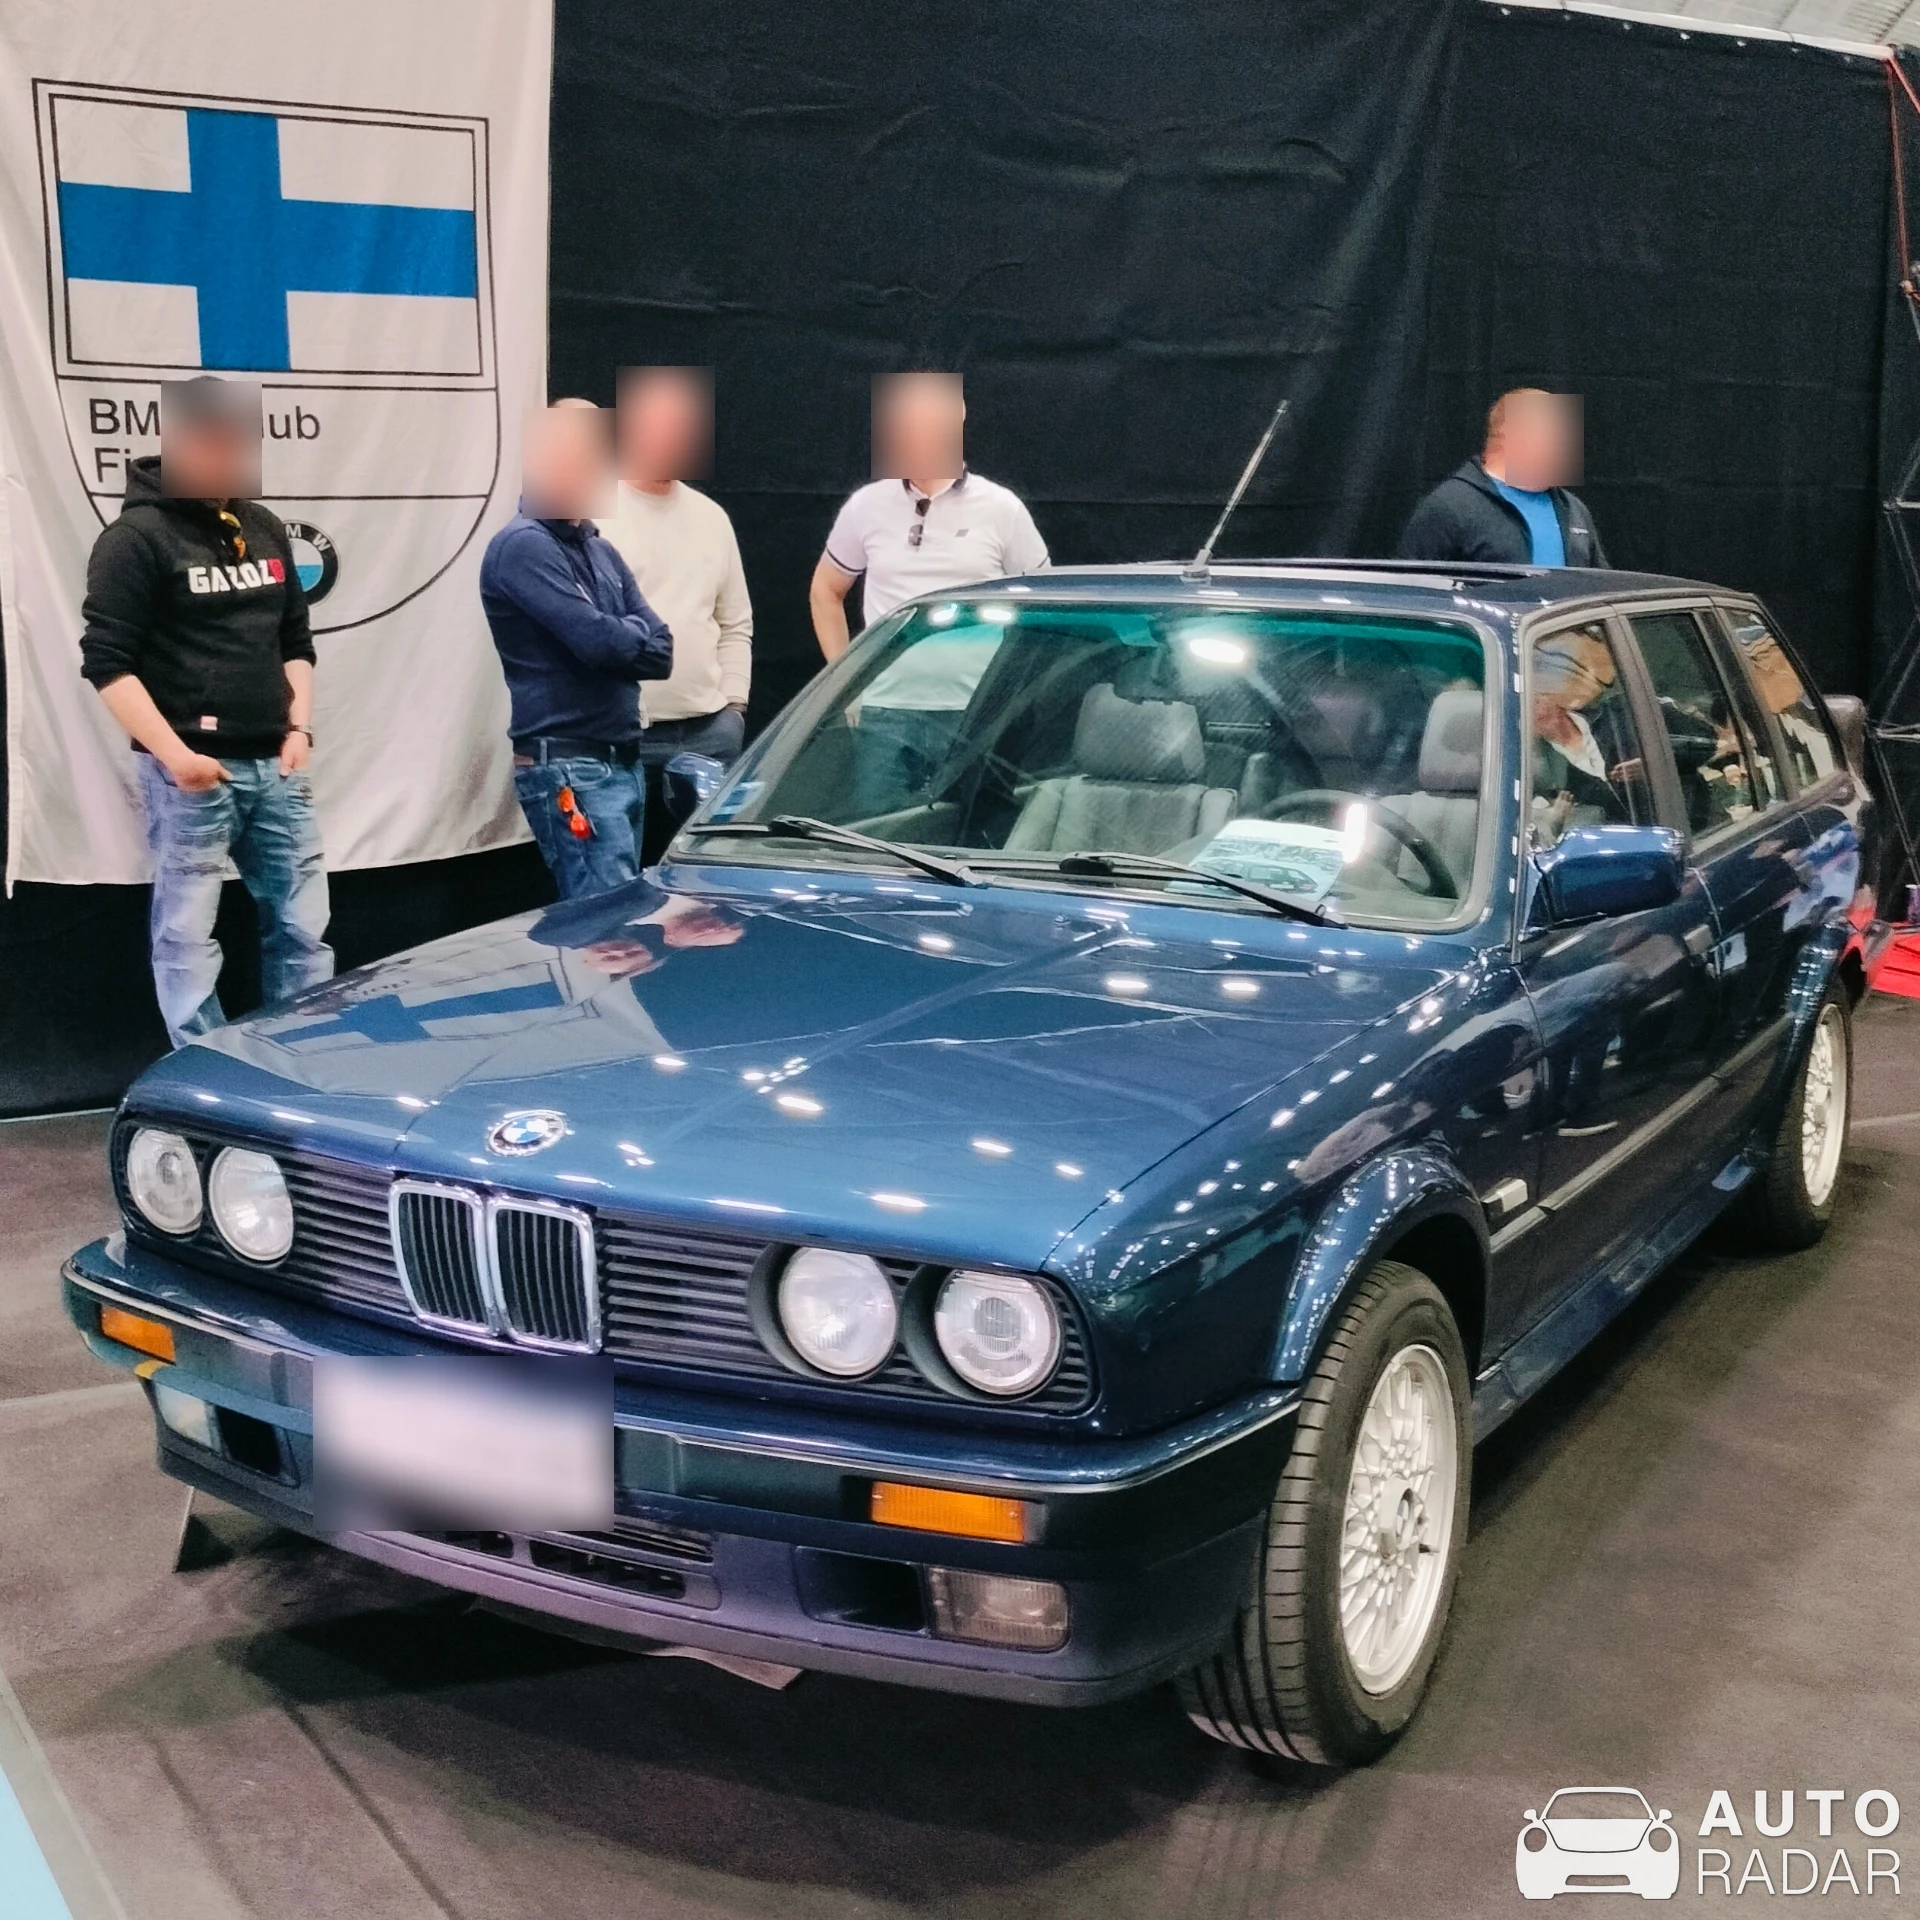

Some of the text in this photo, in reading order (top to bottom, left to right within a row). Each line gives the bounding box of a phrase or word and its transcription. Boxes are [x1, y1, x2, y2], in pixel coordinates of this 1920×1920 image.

[89, 398, 320, 440] BM ub
[285, 524, 331, 551] MW
